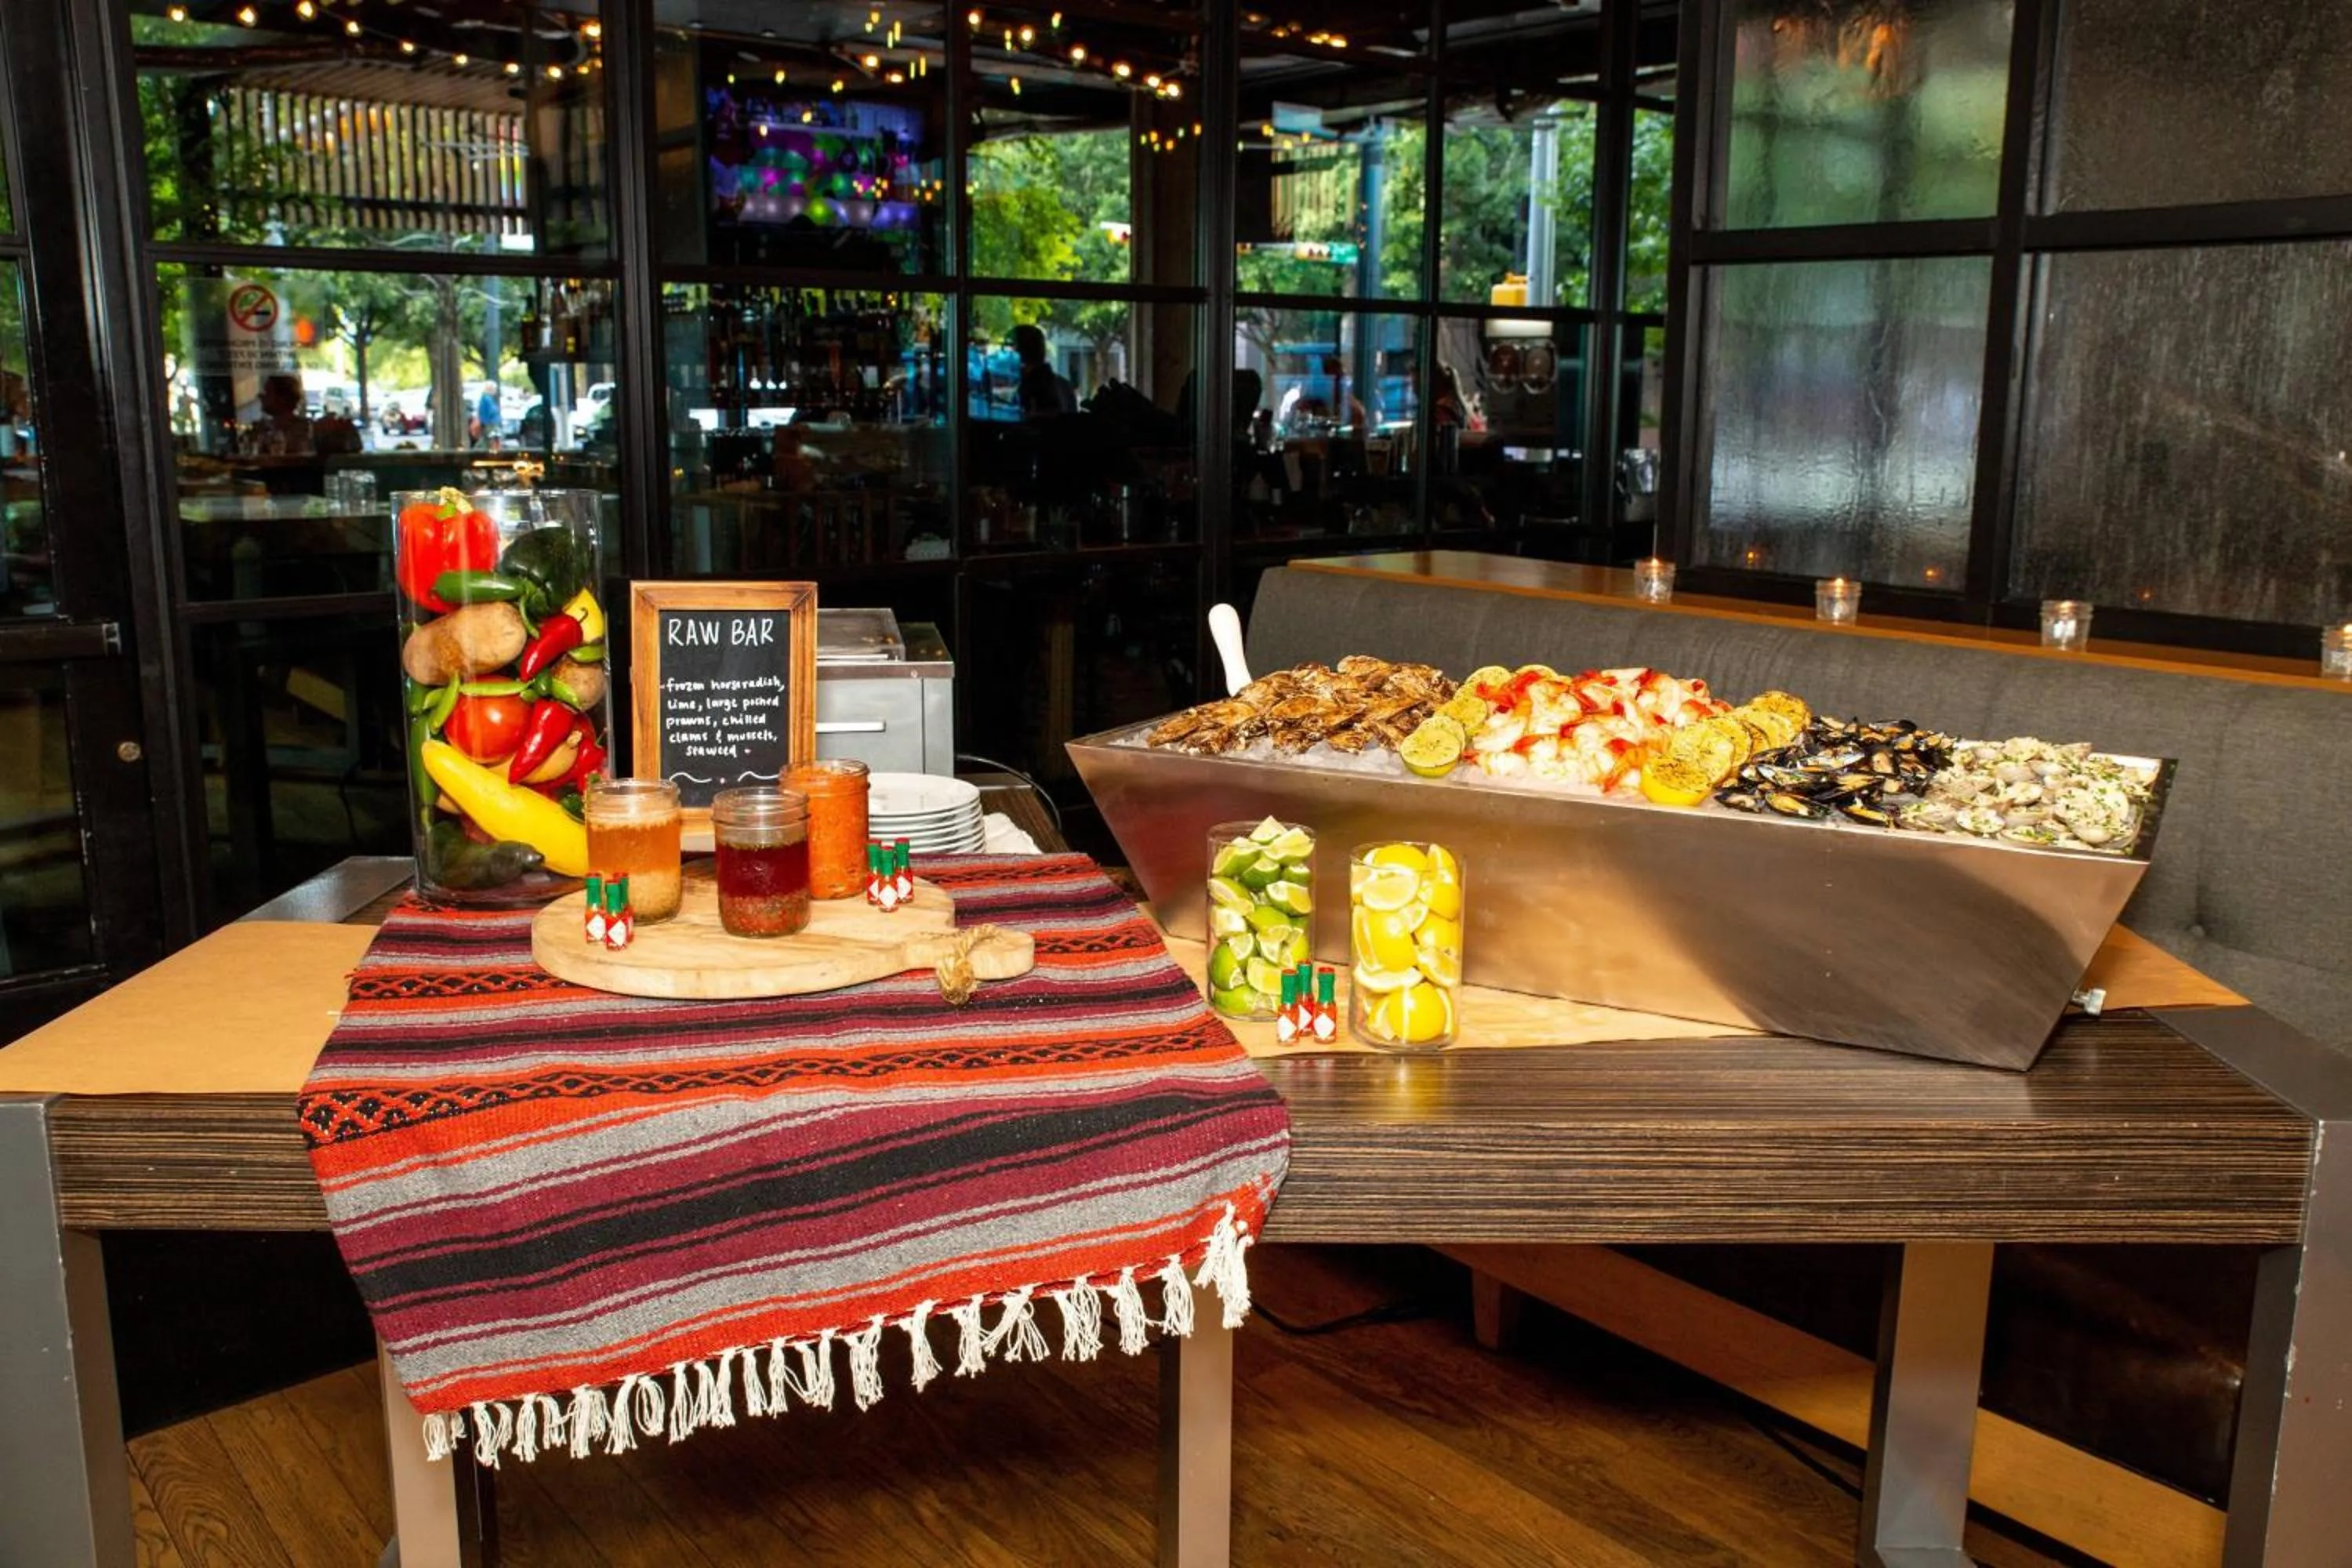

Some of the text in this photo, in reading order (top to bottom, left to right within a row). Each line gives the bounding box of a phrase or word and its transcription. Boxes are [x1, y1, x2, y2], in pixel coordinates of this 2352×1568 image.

[669, 618, 774, 646] RAW BAR
[706, 697, 738, 712] large
[721, 713, 766, 726] chilled
[669, 731, 708, 743] clams
